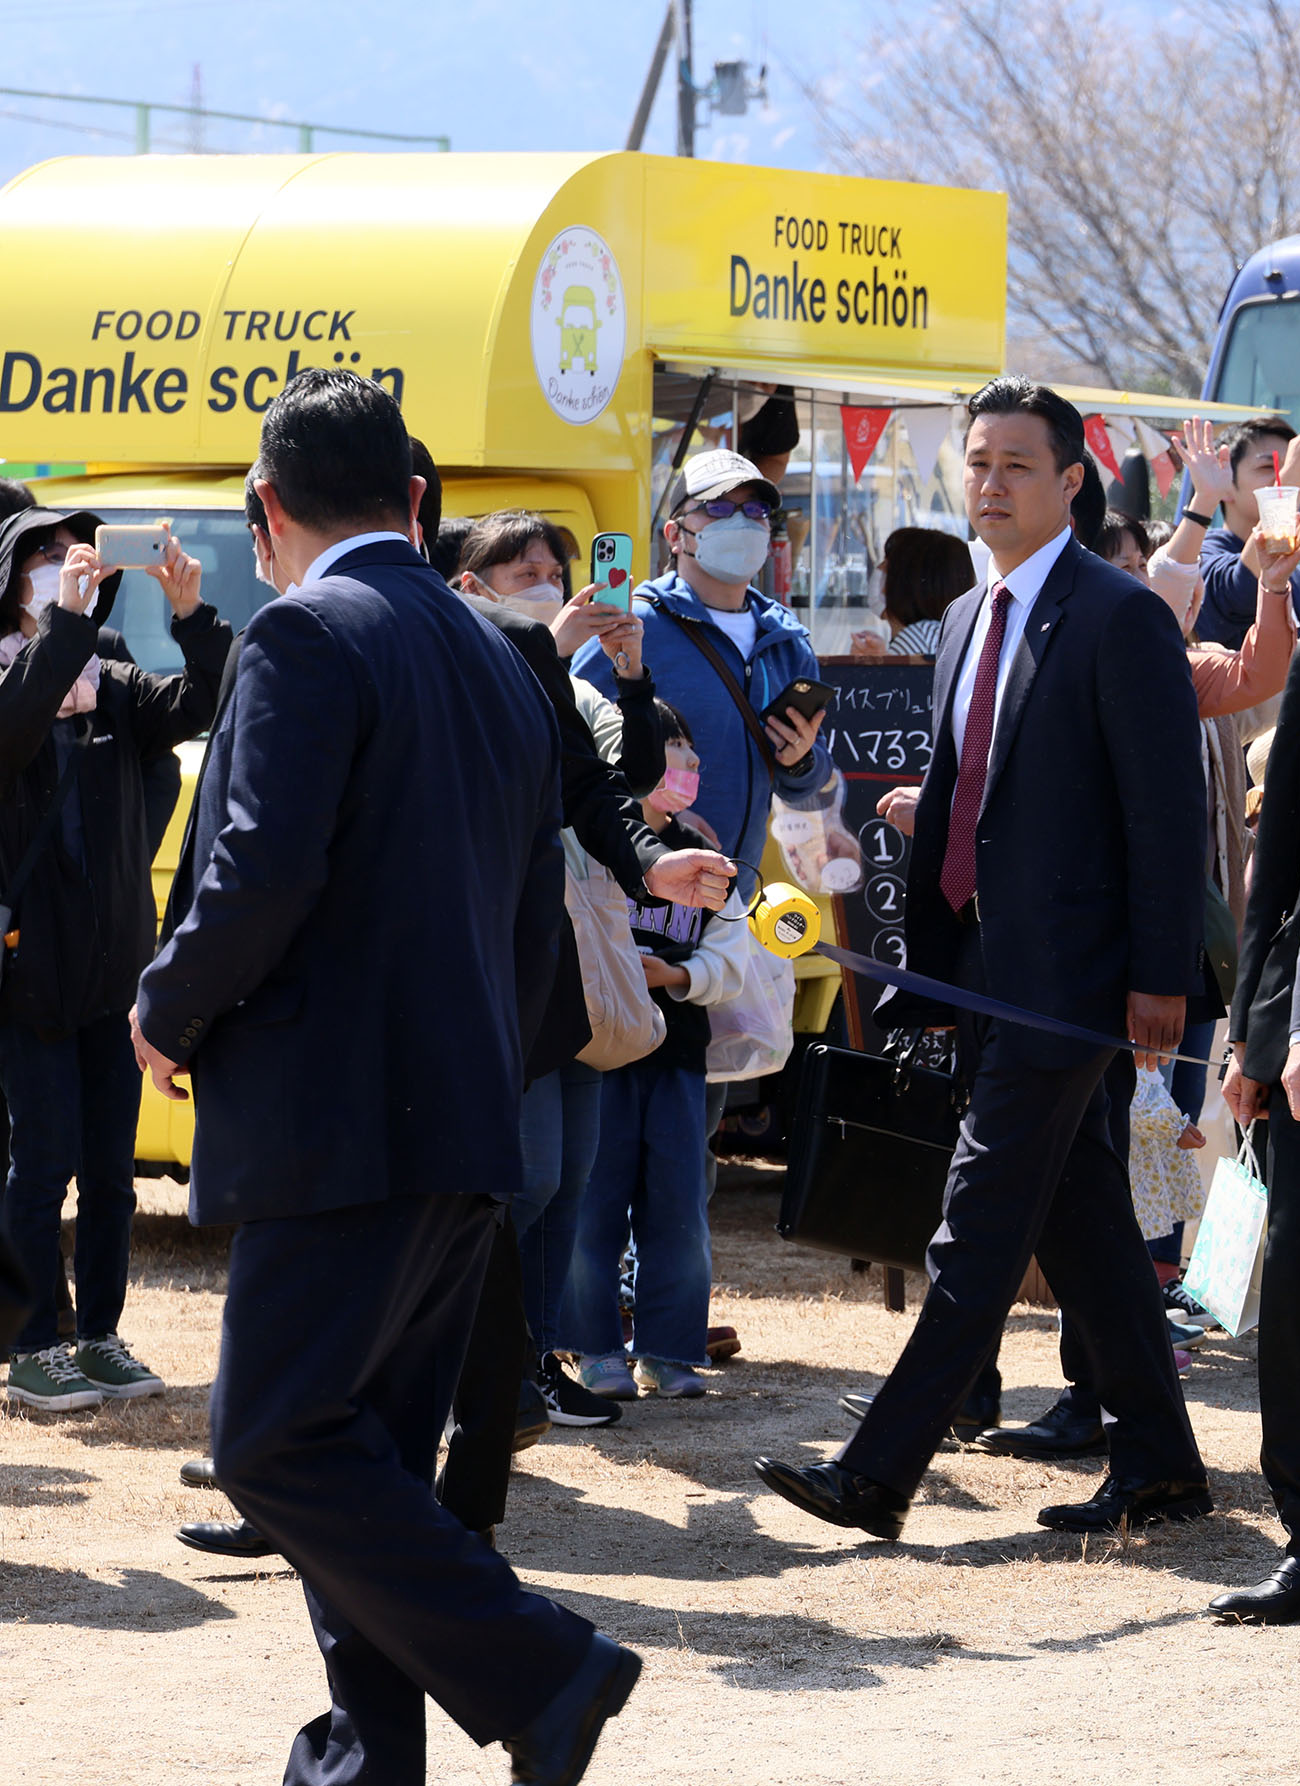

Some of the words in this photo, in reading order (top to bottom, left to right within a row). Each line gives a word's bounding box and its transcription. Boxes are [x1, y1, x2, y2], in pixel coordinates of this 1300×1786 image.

[774, 216, 828, 251] FOOD
[838, 222, 902, 259] TRUCK
[730, 255, 826, 323] Danke
[836, 266, 928, 329] schön
[92, 310, 201, 341] FOOD
[223, 310, 356, 341] TRUCK
[0, 351, 188, 414] Danke
